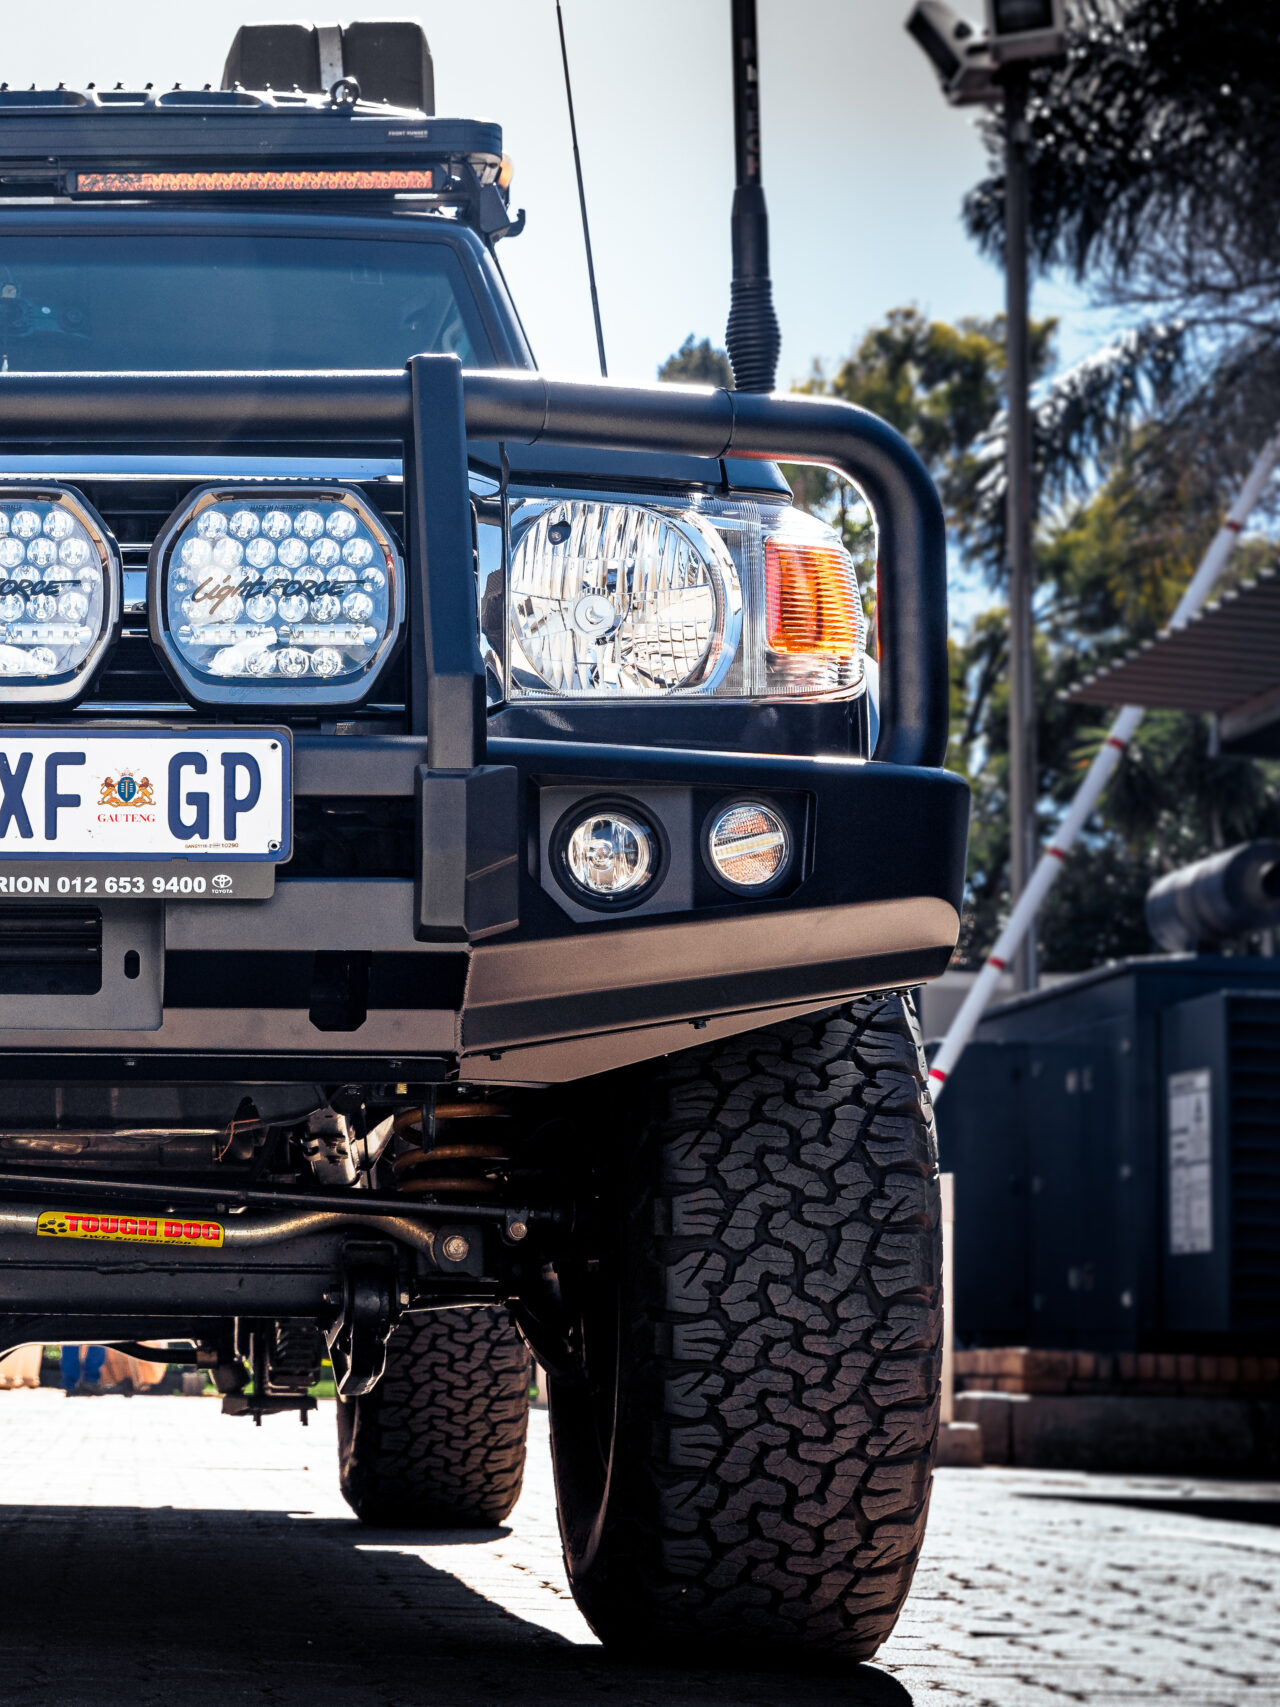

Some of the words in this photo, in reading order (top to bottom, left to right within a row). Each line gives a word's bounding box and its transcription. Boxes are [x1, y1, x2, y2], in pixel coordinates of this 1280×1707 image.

[168, 752, 261, 840] GP
[97, 813, 156, 823] GAUTENG
[57, 876, 98, 894] 012
[104, 876, 145, 894] 653
[152, 876, 207, 894] 9400
[64, 1215, 157, 1236] TOUGH
[164, 1221, 221, 1241] DOG
[115, 1236, 191, 1245] Suspension
